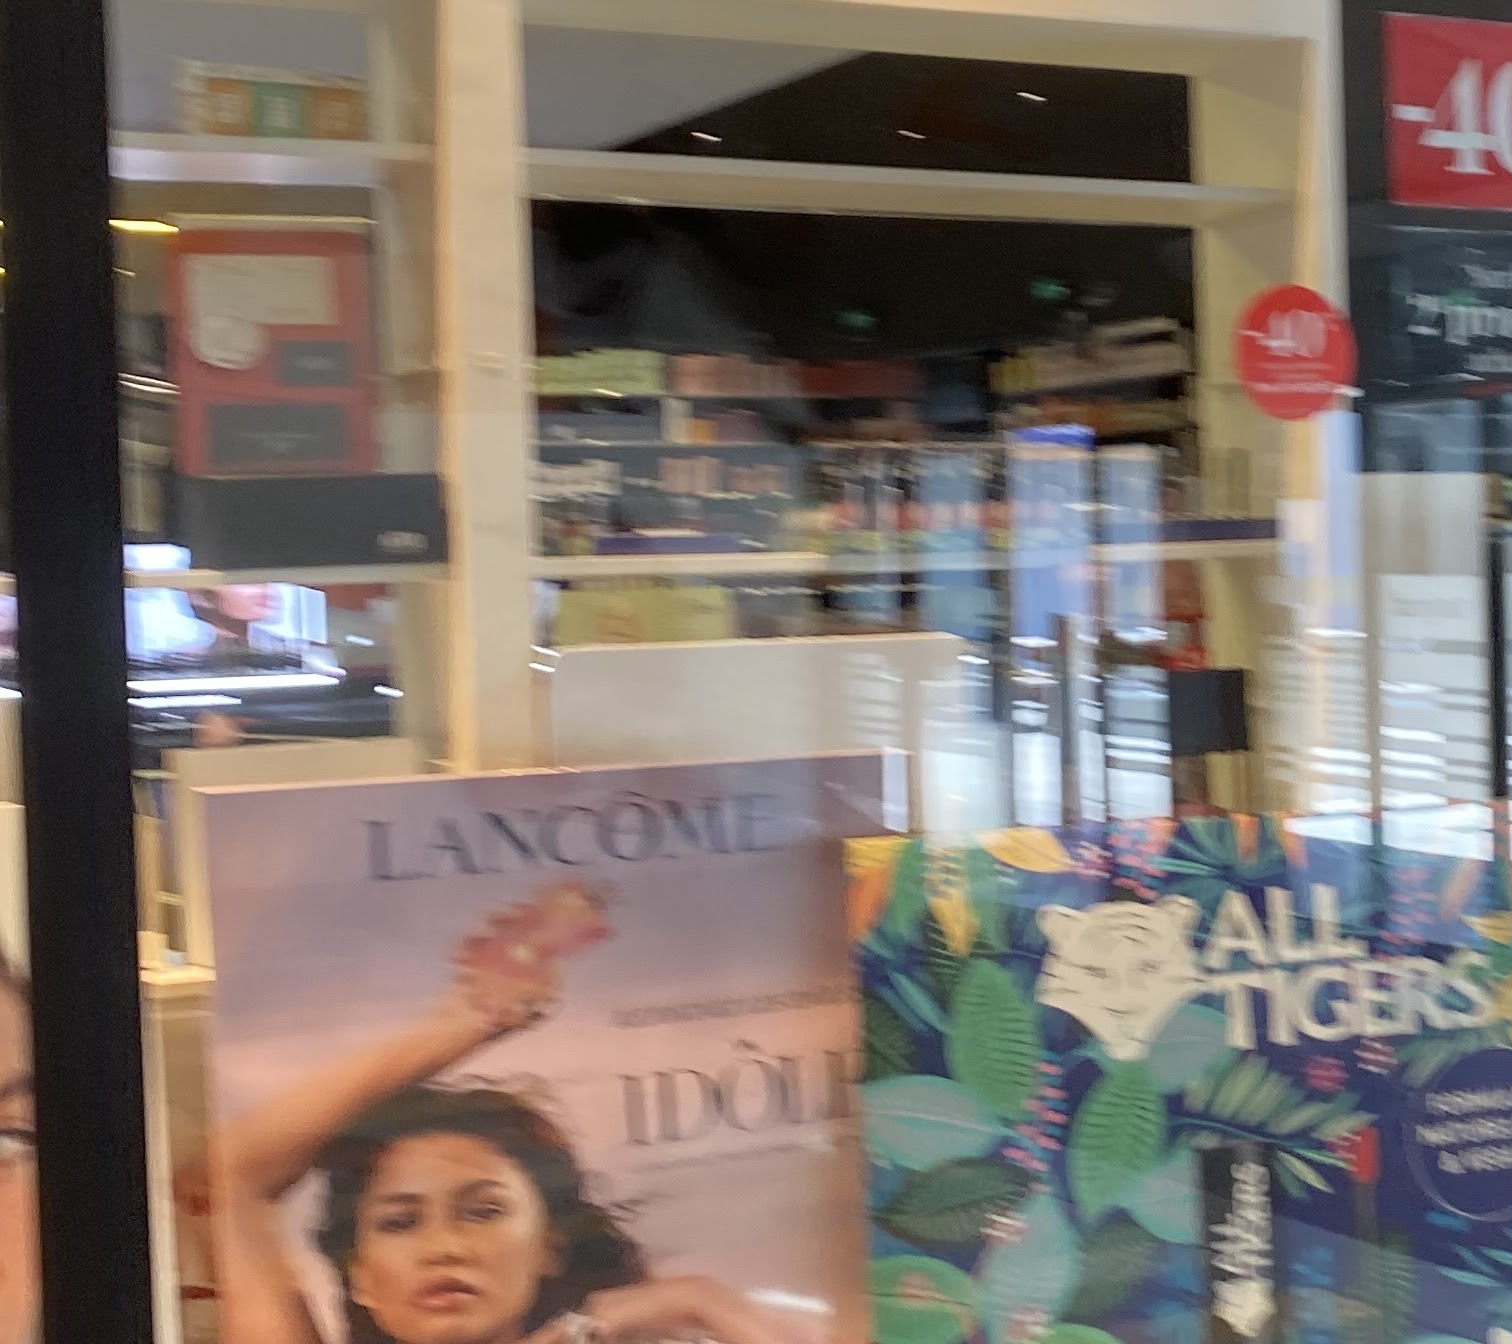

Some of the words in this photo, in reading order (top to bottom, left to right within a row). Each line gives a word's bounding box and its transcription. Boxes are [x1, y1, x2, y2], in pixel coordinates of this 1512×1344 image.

[364, 789, 780, 882] LANCÔME
[1203, 882, 1371, 970] ALL
[1205, 943, 1492, 1050] TIGERS
